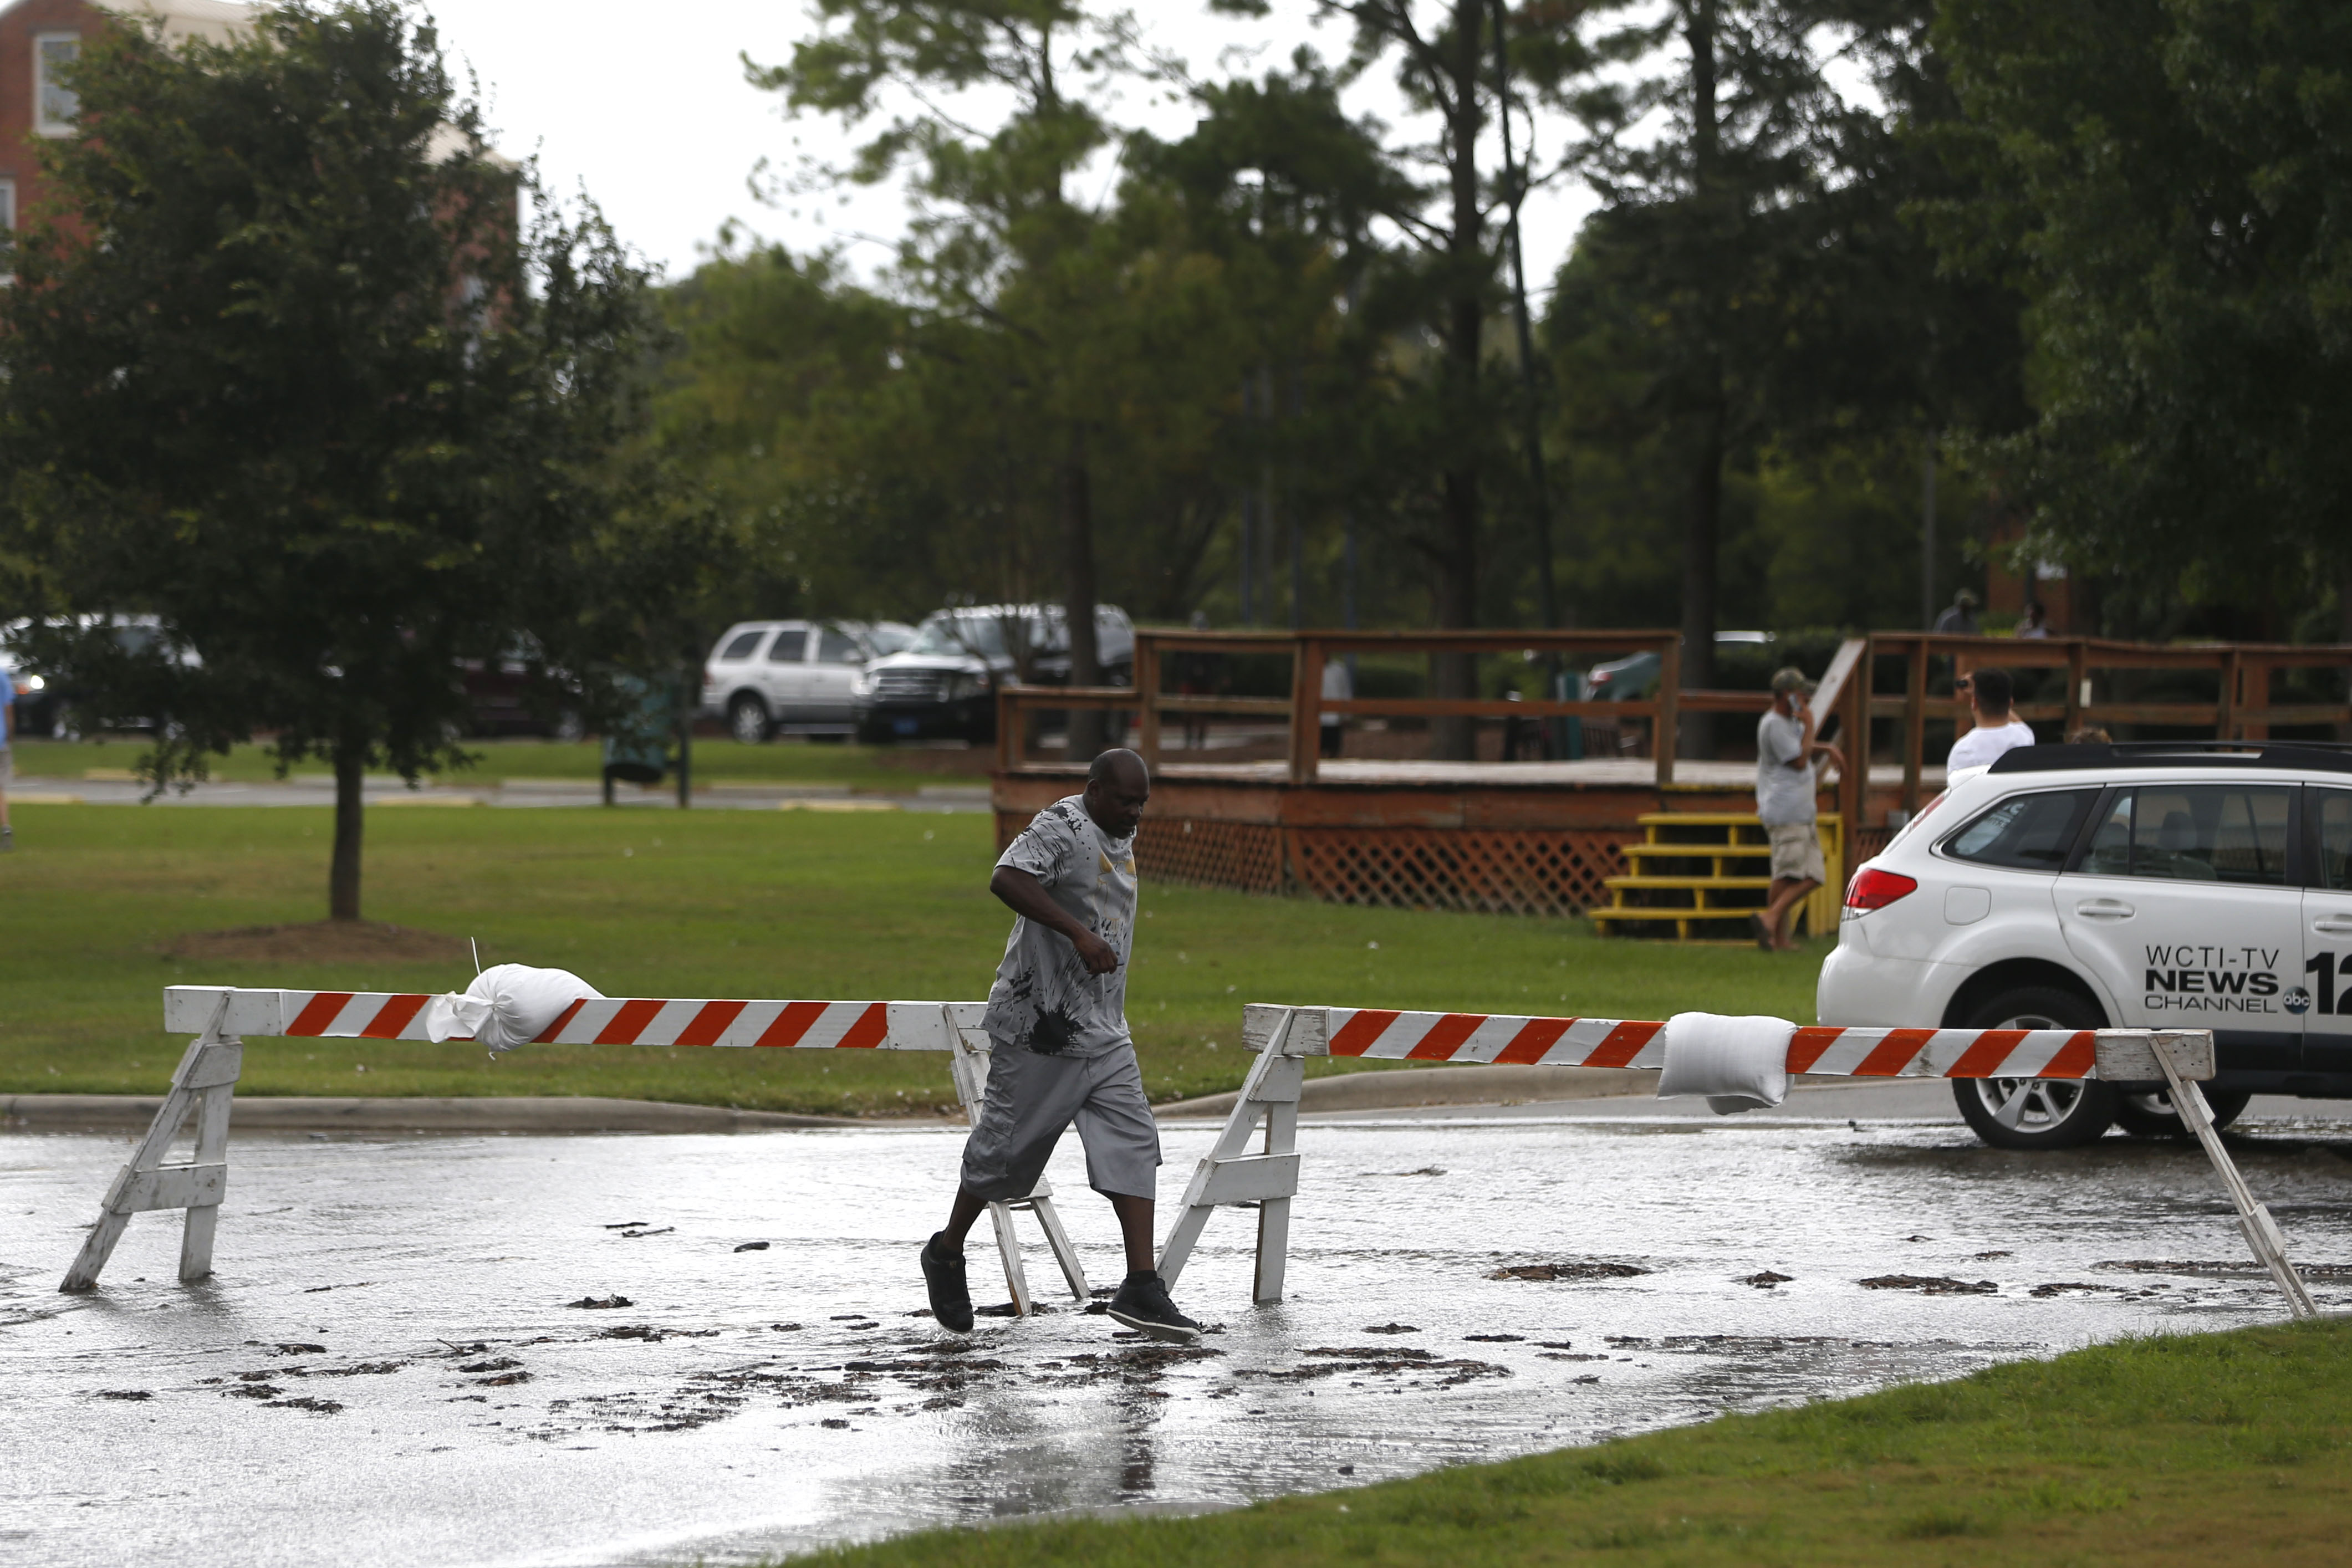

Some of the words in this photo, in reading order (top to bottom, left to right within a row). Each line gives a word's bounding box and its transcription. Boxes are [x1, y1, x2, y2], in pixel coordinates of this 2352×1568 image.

[2146, 944, 2279, 969] WCTI-TV
[2145, 969, 2279, 996] NEWS
[2145, 995, 2278, 1014] CHANNEL
[2283, 992, 2310, 1007] abc
